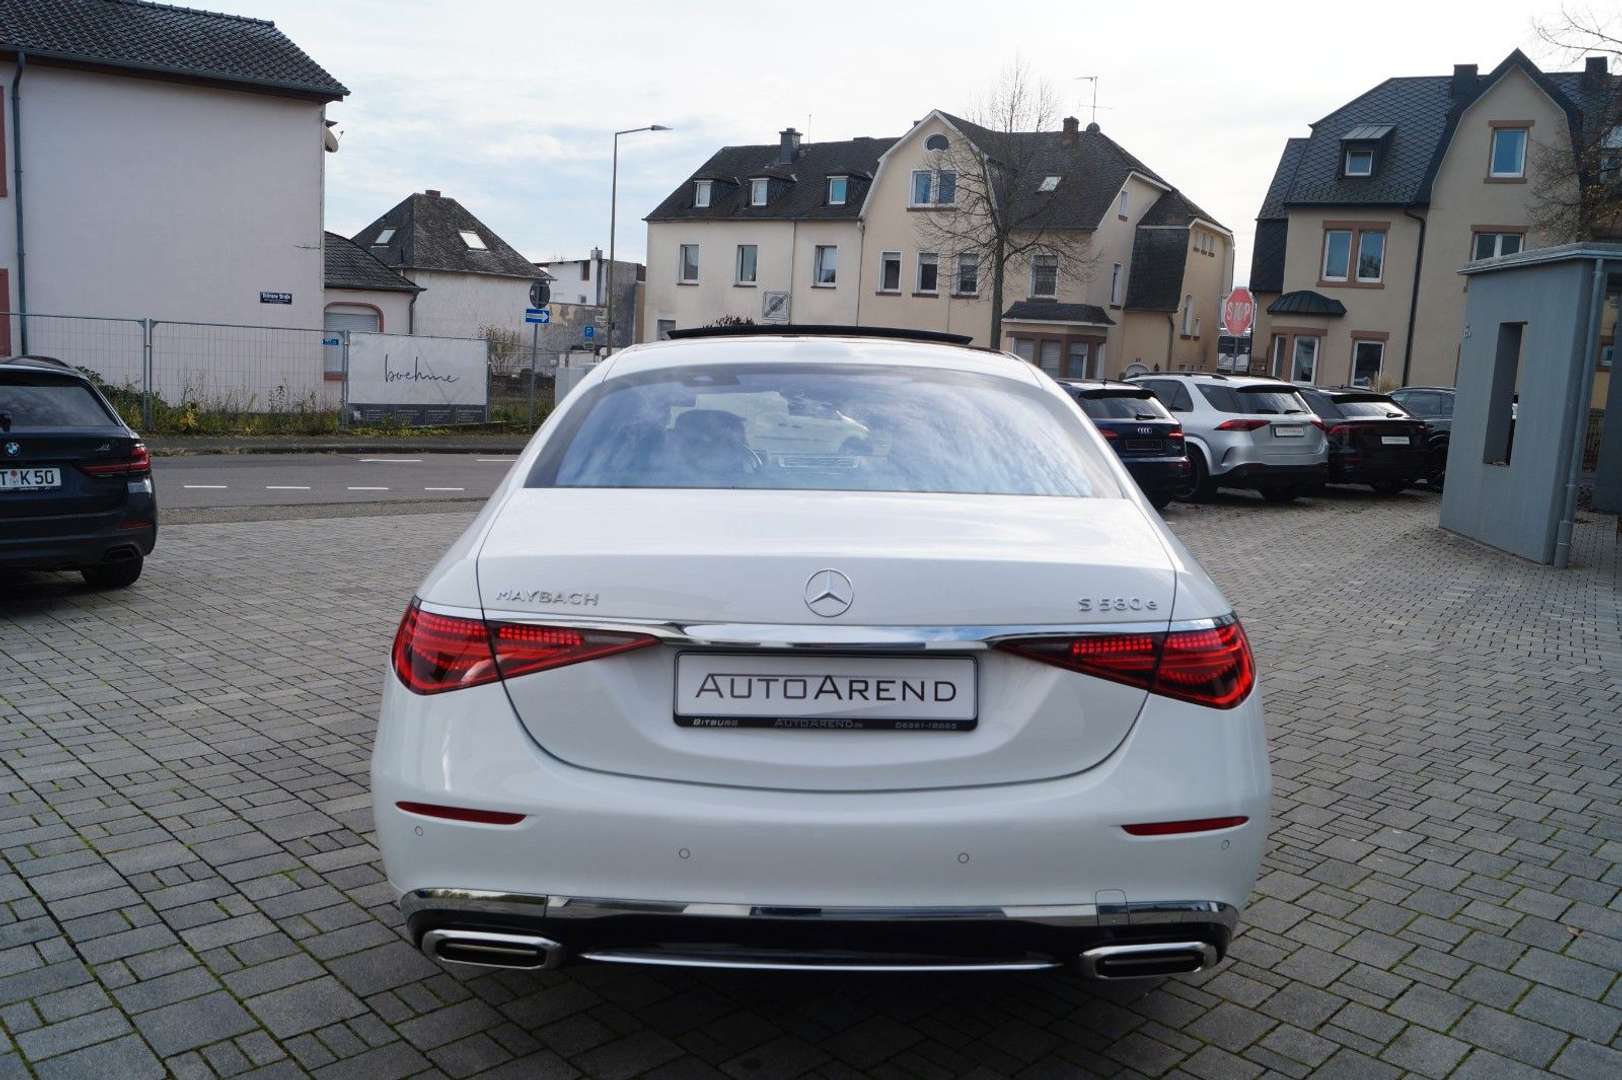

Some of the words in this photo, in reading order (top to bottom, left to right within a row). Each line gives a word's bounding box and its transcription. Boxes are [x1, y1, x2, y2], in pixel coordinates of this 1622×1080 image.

[1226, 301, 1251, 322] STOP
[20, 469, 31, 485] K
[34, 469, 54, 484] 50
[496, 590, 600, 607] MAYBACH
[1078, 598, 1092, 612] S
